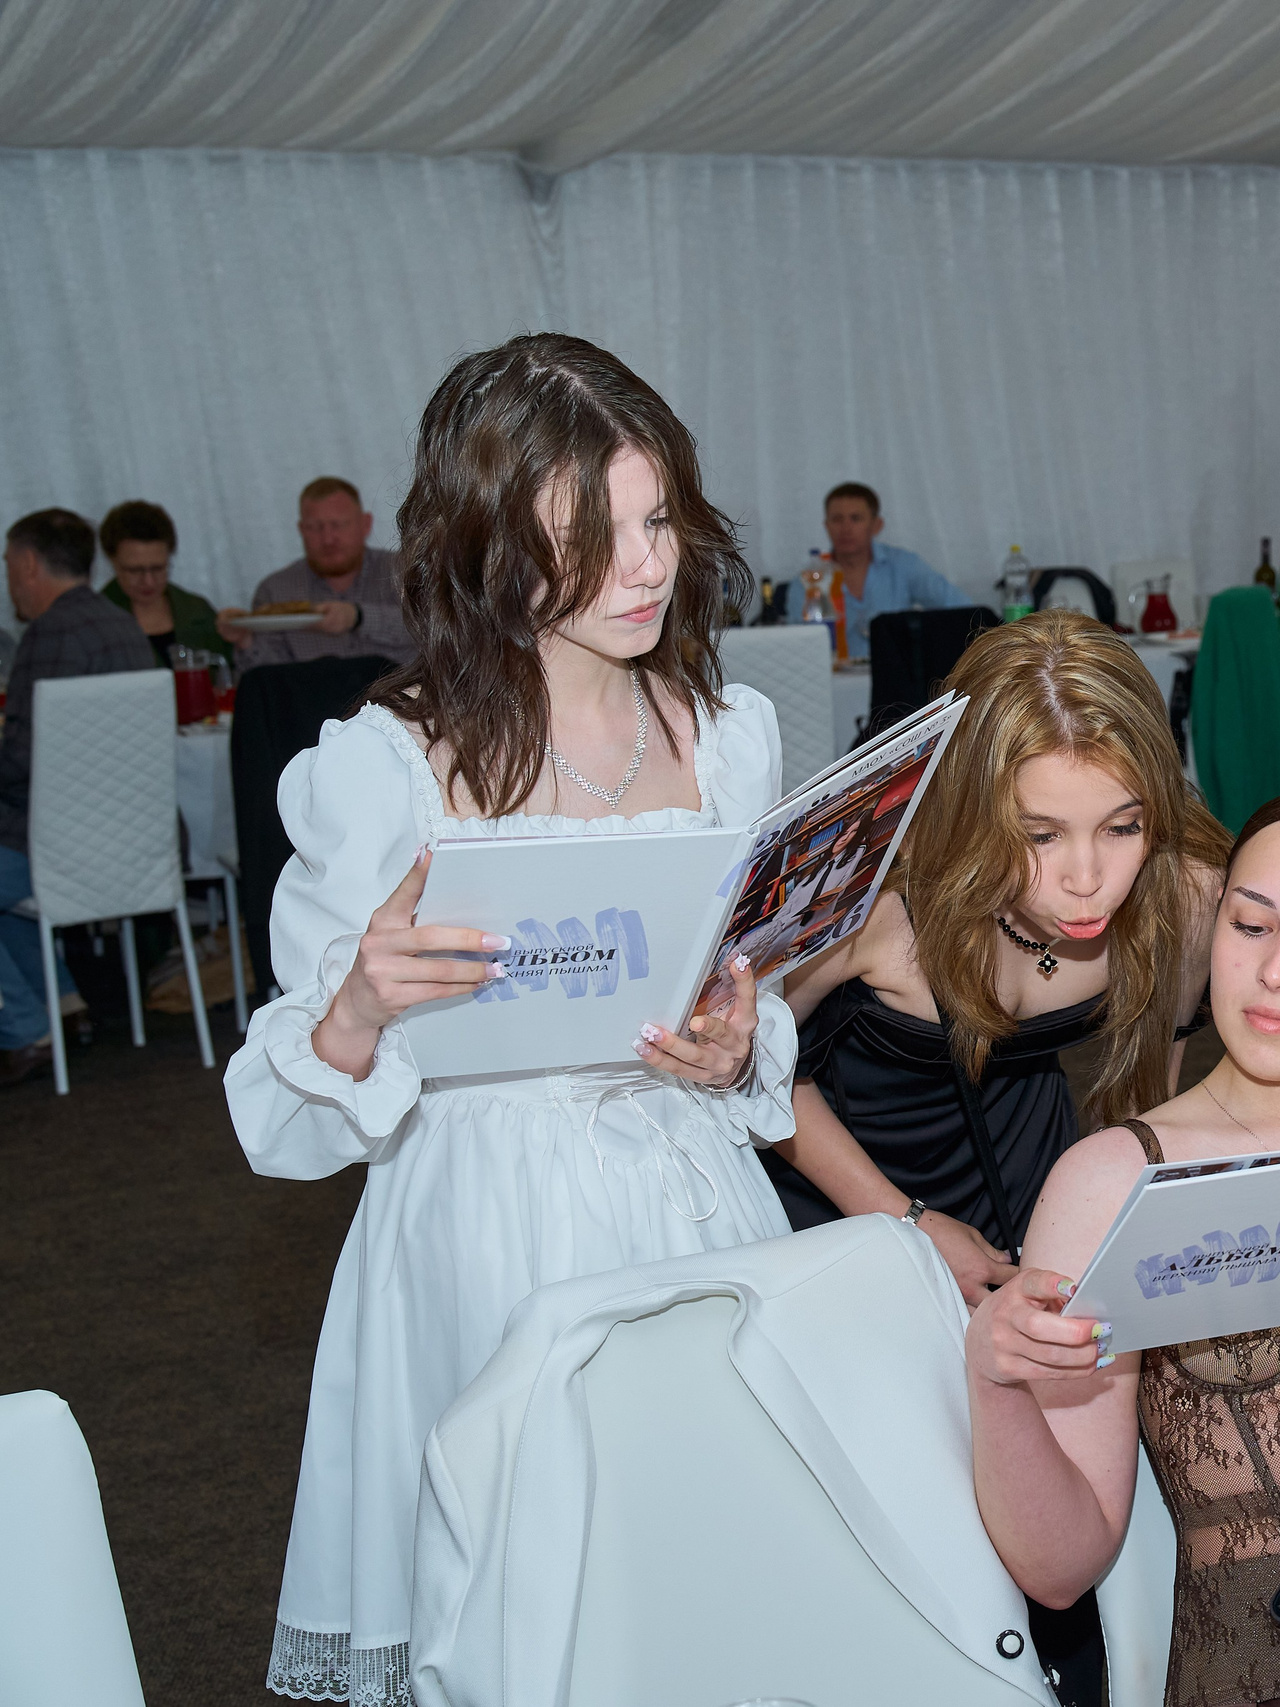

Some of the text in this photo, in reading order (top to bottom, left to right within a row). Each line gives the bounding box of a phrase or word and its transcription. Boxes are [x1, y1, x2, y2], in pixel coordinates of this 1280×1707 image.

[852, 752, 887, 777] МАОУ
[748, 815, 807, 864] 20
[797, 903, 865, 964] 26
[490, 948, 618, 967] ЛЬБОМ
[514, 943, 595, 956] ВЫПУСКНОЙ
[504, 964, 609, 978] ХНЯЯ ПЫШМА
[1152, 1257, 1278, 1282] ВЕРХНЯЯ ПЫШМА
